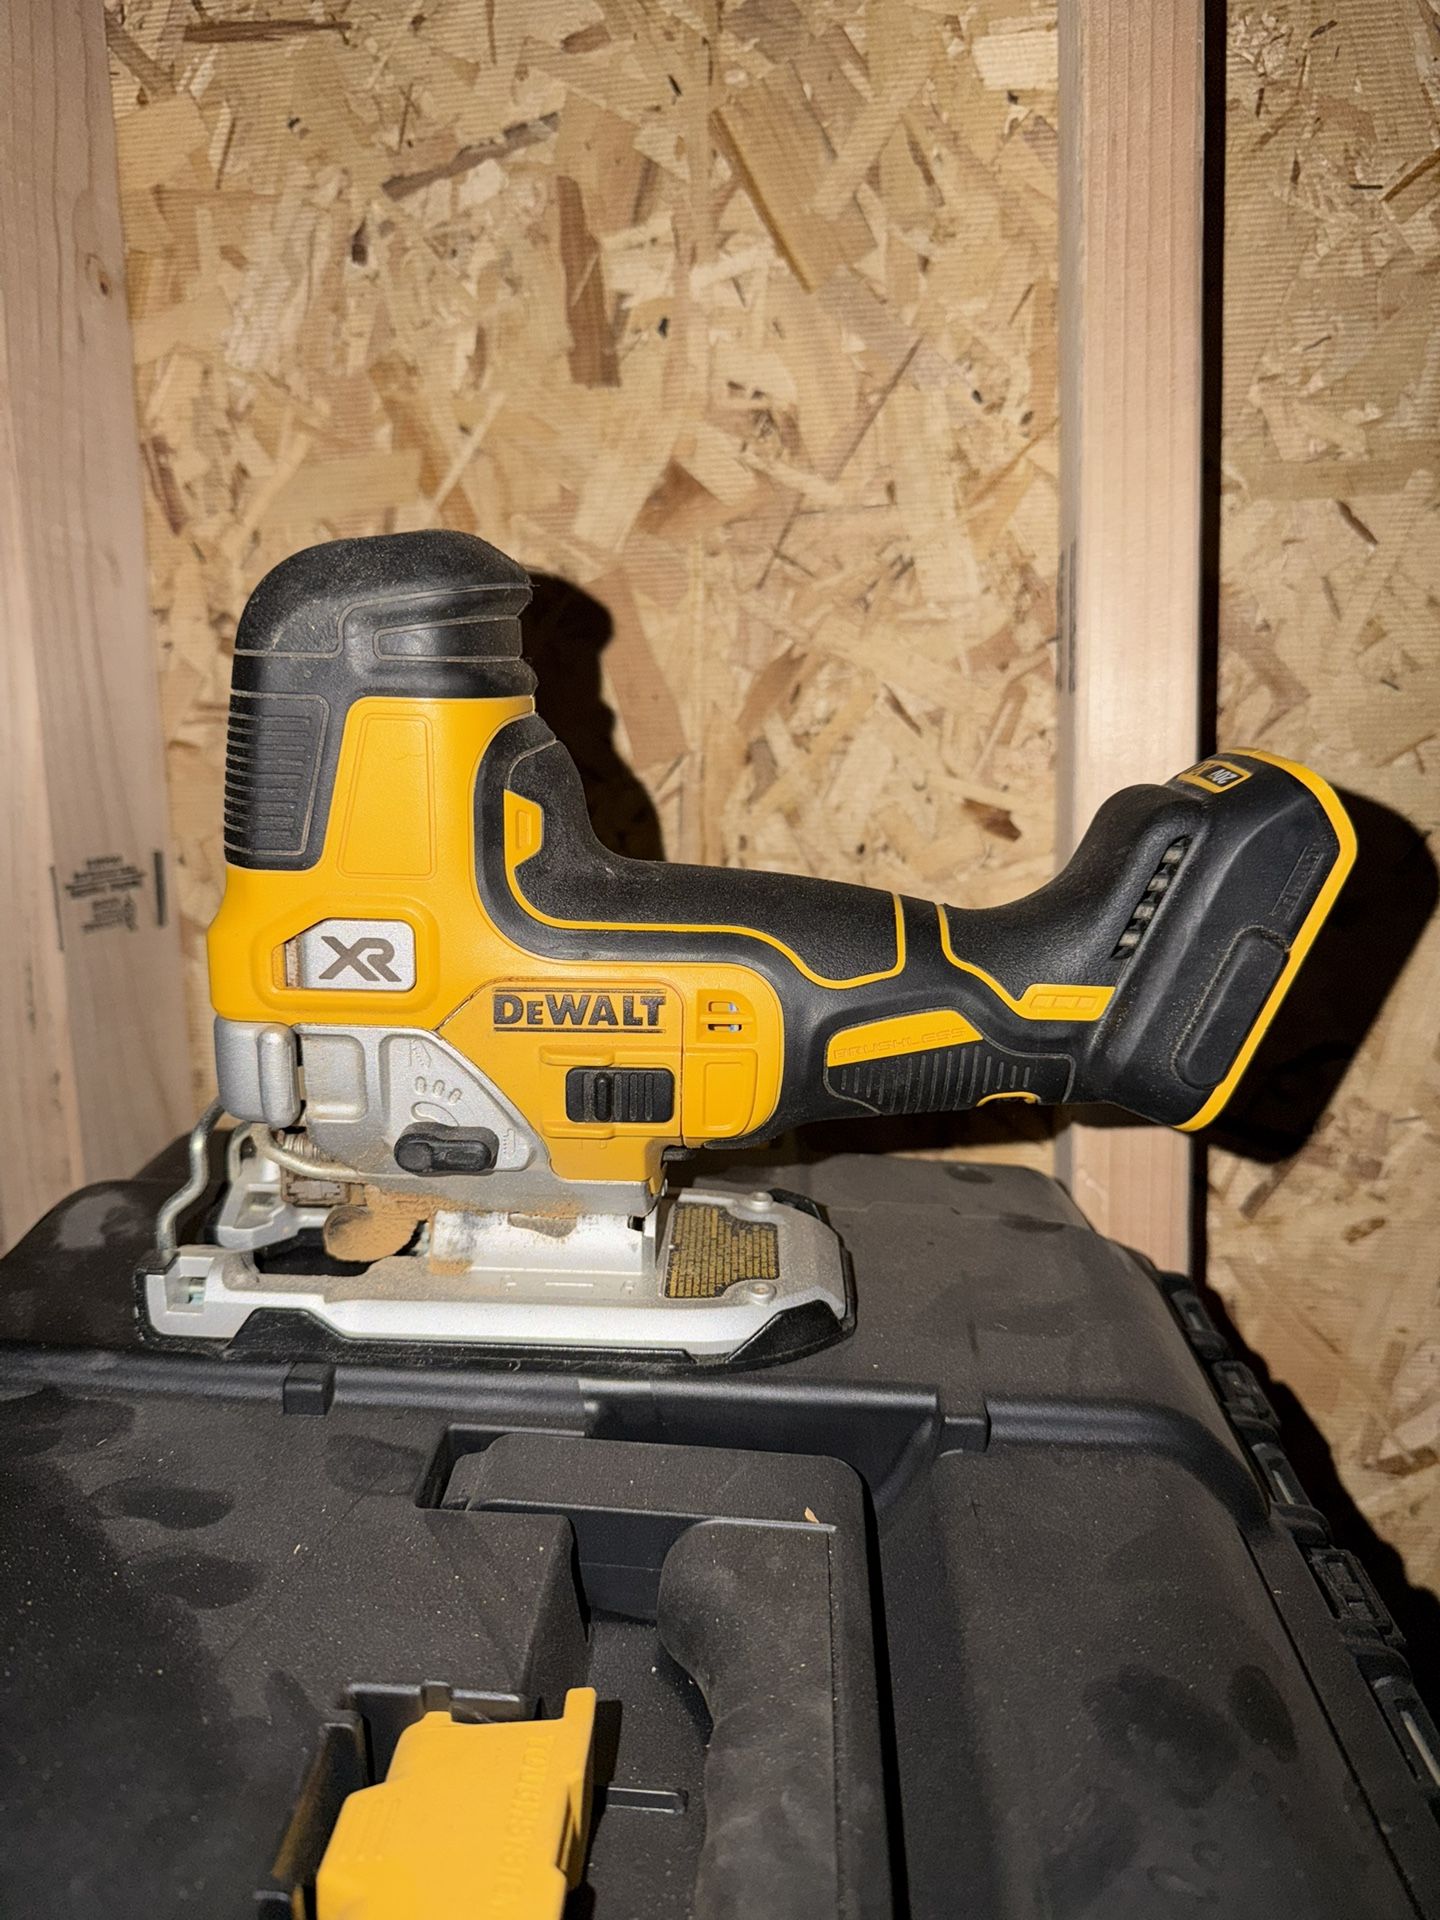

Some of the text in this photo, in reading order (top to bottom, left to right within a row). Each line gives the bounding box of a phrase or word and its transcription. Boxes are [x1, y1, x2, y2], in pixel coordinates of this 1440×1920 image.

[1209, 768, 1239, 785] 20V
[317, 935, 402, 983] XR
[493, 994, 666, 1026] DEWALT
[833, 1026, 967, 1060] BRUSHLESS
